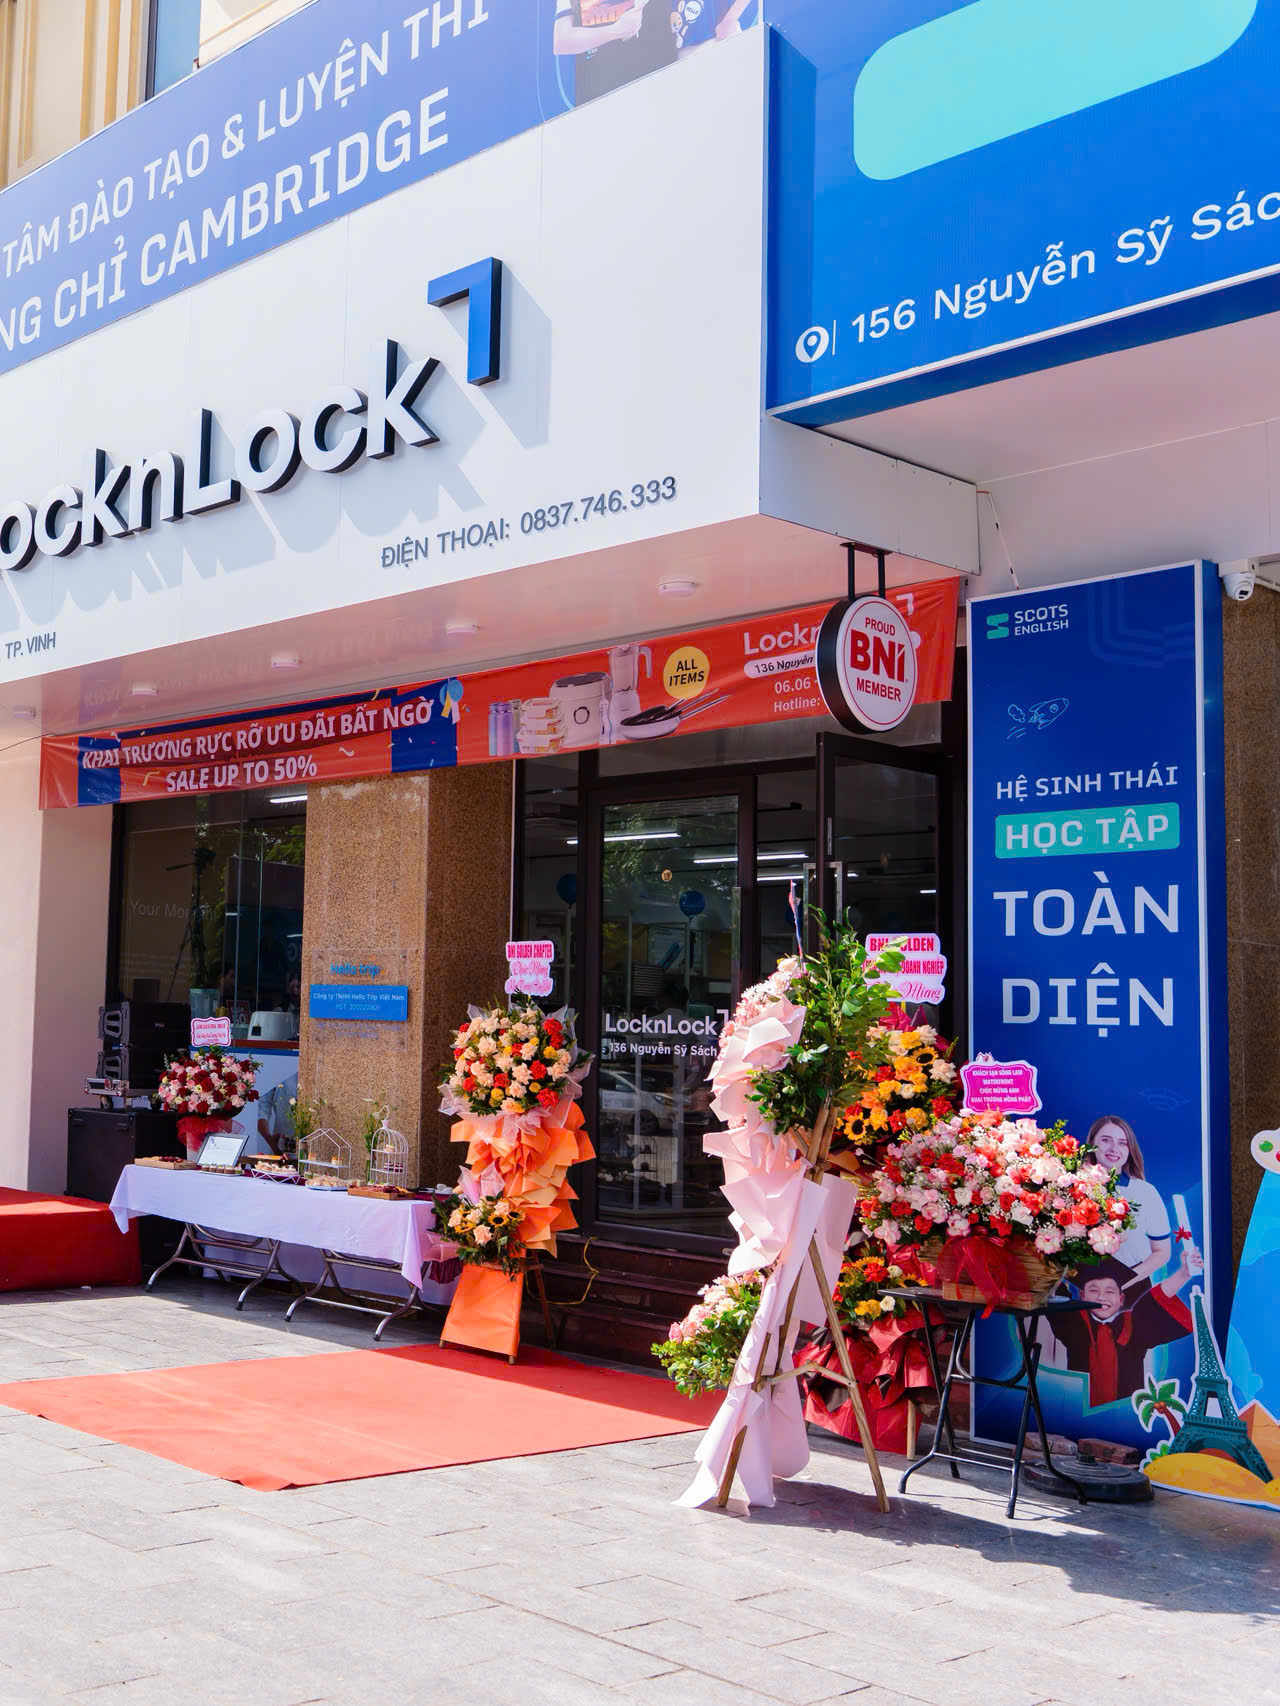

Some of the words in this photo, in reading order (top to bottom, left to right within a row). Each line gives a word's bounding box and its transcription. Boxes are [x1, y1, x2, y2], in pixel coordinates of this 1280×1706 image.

[2, 214, 62, 279] TÂM
[67, 175, 134, 244] ĐÀO
[144, 134, 209, 201] TẠO
[221, 114, 246, 160] &
[258, 30, 389, 143] LUYỆN
[404, 0, 489, 61] THI
[54, 237, 127, 328] CHỈ
[140, 87, 449, 286] CAMBRIDGE
[851, 299, 917, 344] 156
[934, 241, 1095, 319] Nguyễn
[1116, 216, 1174, 266] Sỹ
[1190, 190, 1280, 241] Sác
[381, 536, 429, 568] ĐIỆN
[437, 518, 511, 554] THOẠI:
[520, 476, 677, 534] 0837.746.333
[1014, 604, 1069, 623] SCOTS
[864, 616, 896, 637] PROUD
[1014, 619, 1069, 636] ENGLISH
[5, 641, 24, 659] TP.
[26, 632, 57, 653] VINH
[676, 657, 698, 673] ALL
[755, 659, 775, 674] 136
[776, 654, 813, 673] Nguyễn
[669, 671, 705, 687] ITEMS
[774, 676, 812, 695] 06.06
[855, 677, 902, 702] MEMBER
[773, 695, 821, 713] Hotline:
[82, 747, 121, 770] KHAI
[122, 736, 192, 765] TRƯƠNG
[196, 731, 232, 760] RỰC
[236, 721, 266, 750] RỠ
[267, 722, 298, 747] ƯU
[300, 711, 336, 742] ĐÃI
[340, 703, 380, 736] BẤT
[383, 699, 434, 730] NGỜ
[166, 769, 209, 793] SALE
[213, 764, 241, 788] UP
[243, 760, 269, 785] TO
[273, 753, 318, 781] 50%
[996, 774, 1029, 803] HỆ
[1035, 772, 1102, 797] SINH
[1109, 761, 1179, 790] THÁI
[1005, 820, 1083, 854] HỌC
[1095, 808, 1169, 849] TẬP
[130, 900, 160, 916] Your
[993, 871, 1179, 937] TOÀN
[533, 943, 553, 958] CHAPTER
[330, 961, 357, 976] Hello
[922, 958, 944, 975] NGHIỆP
[1001, 962, 1174, 1038] DIỆN
[605, 1013, 718, 1036] LocknLock
[610, 1042, 627, 1053] 136
[630, 1041, 671, 1056] Nguyễn
[673, 1045, 688, 1057] Sỹ
[690, 1045, 717, 1057] Sách
